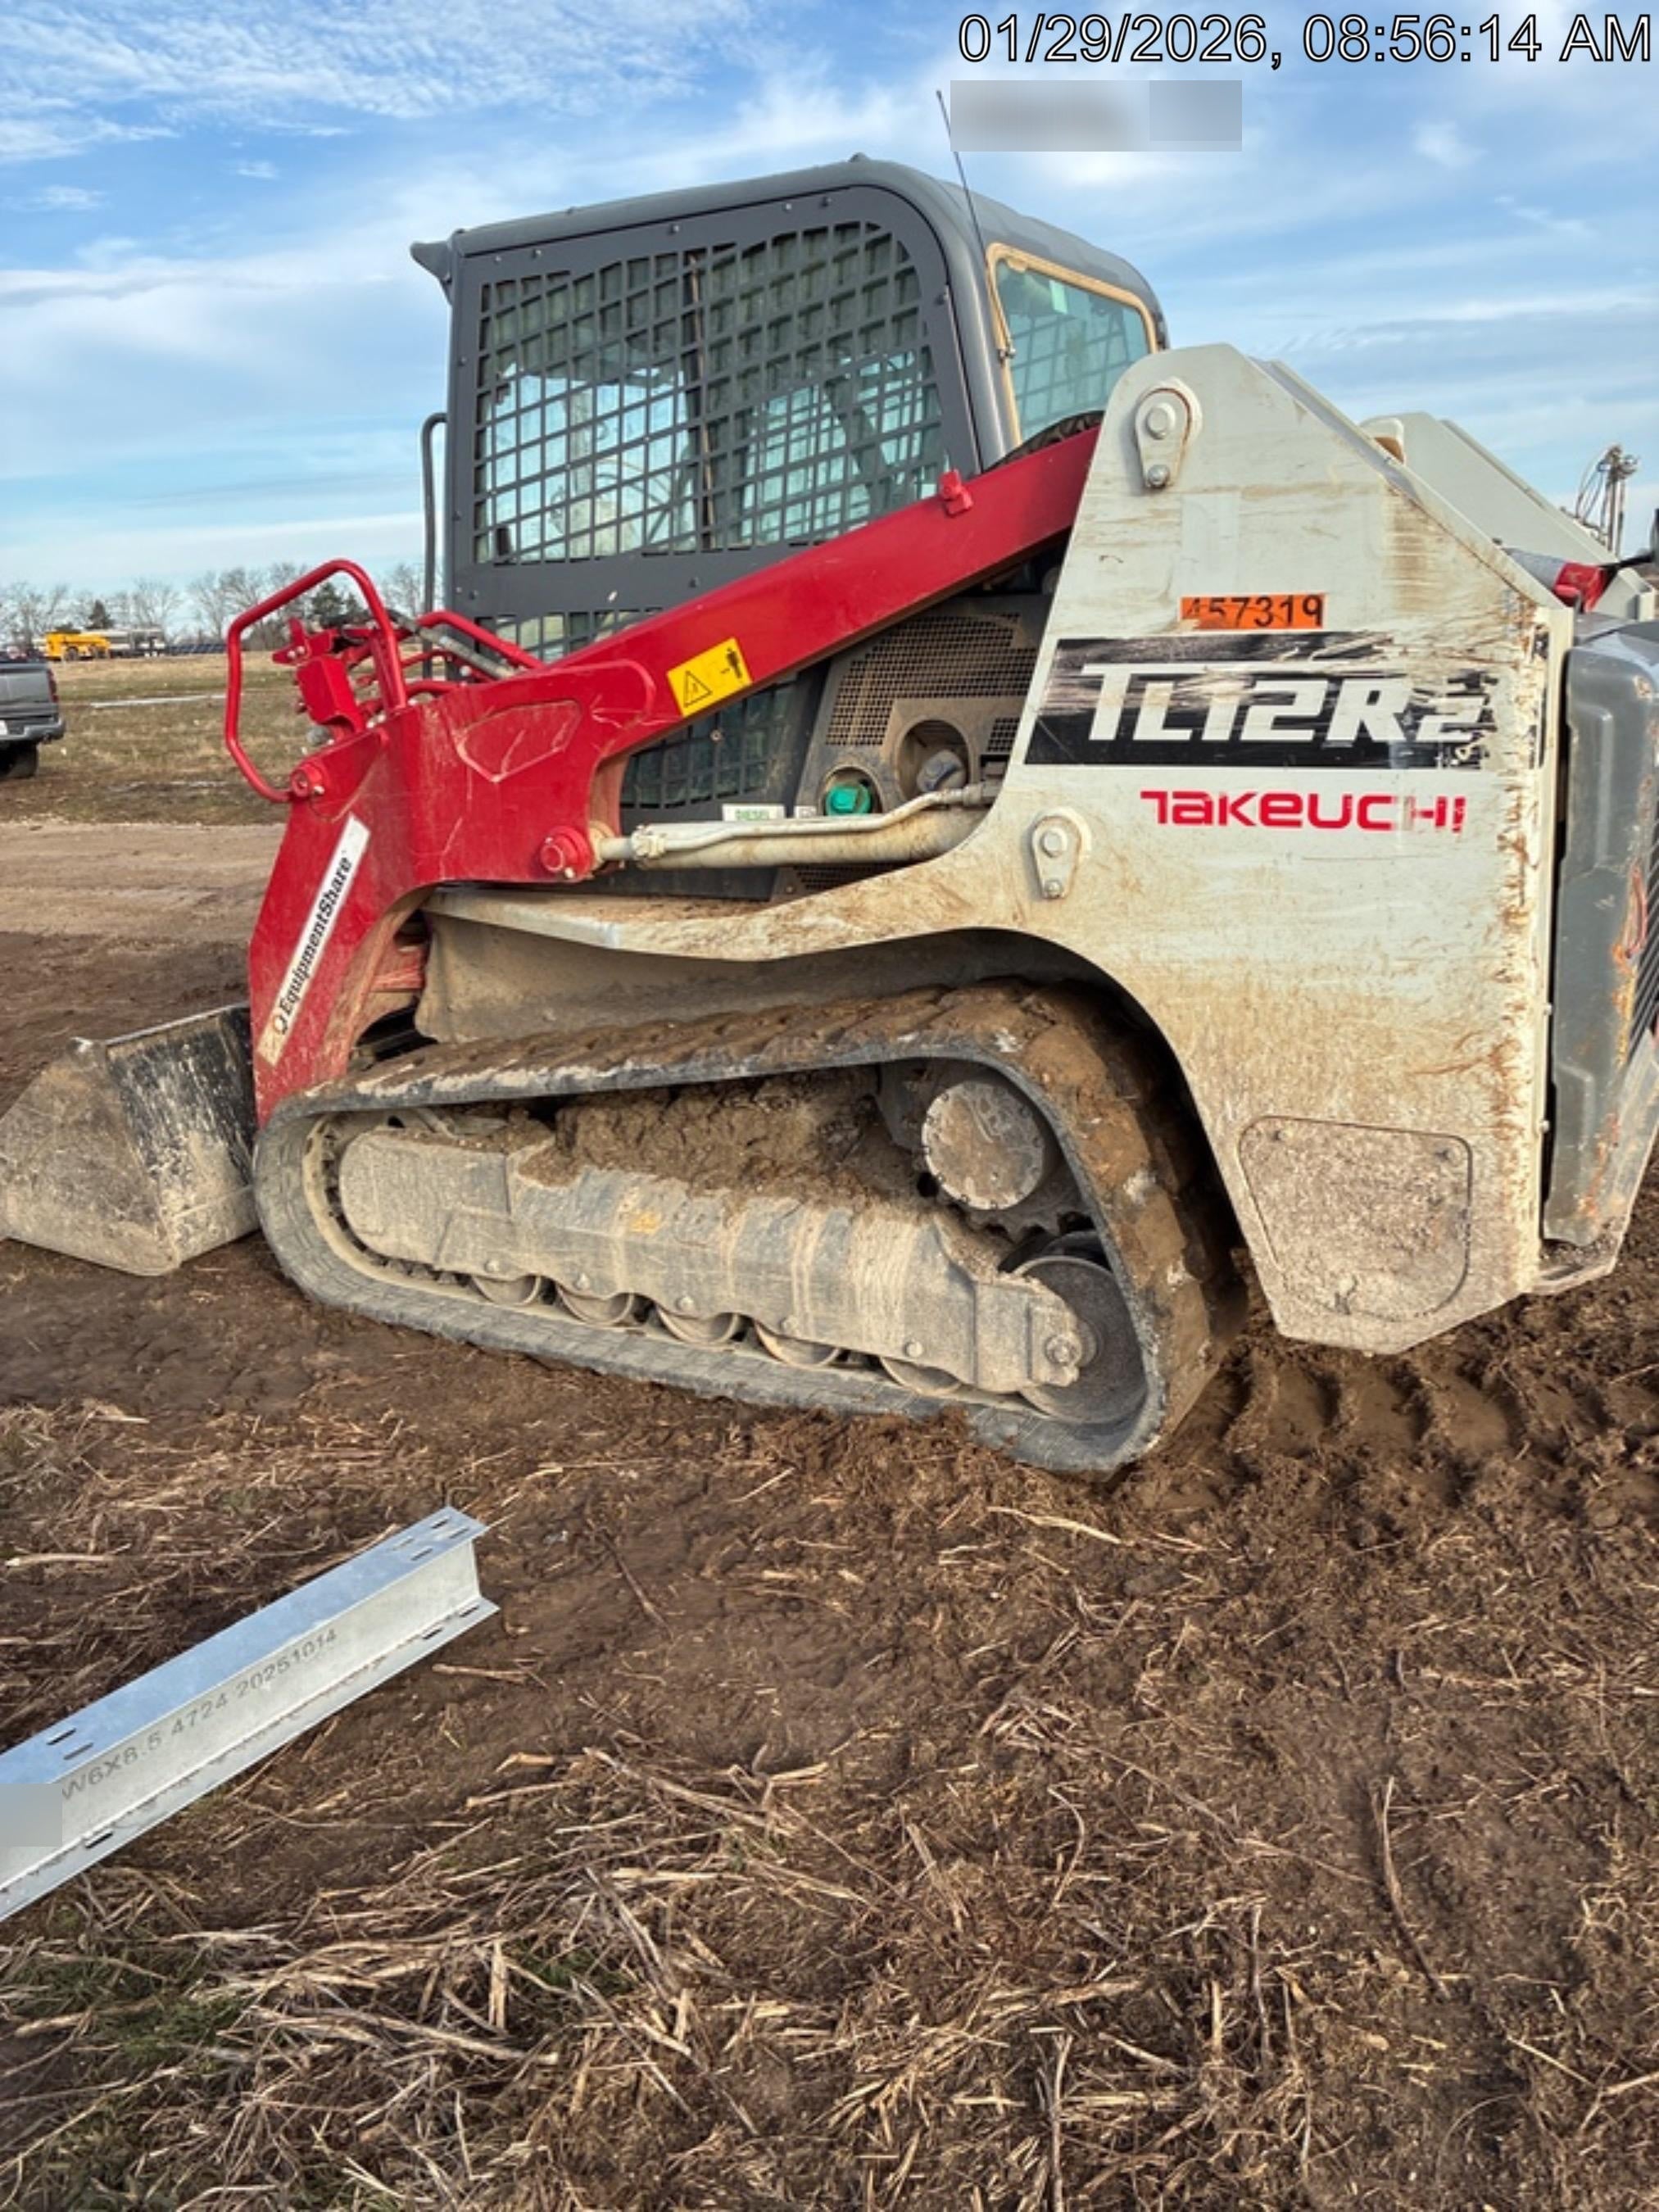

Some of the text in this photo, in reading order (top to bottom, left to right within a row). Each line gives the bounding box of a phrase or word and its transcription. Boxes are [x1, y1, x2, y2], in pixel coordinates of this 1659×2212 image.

[279, 857, 352, 1018] EquipmentShare
[171, 1693, 228, 1735] 4724
[237, 1628, 338, 1698] 20251014
